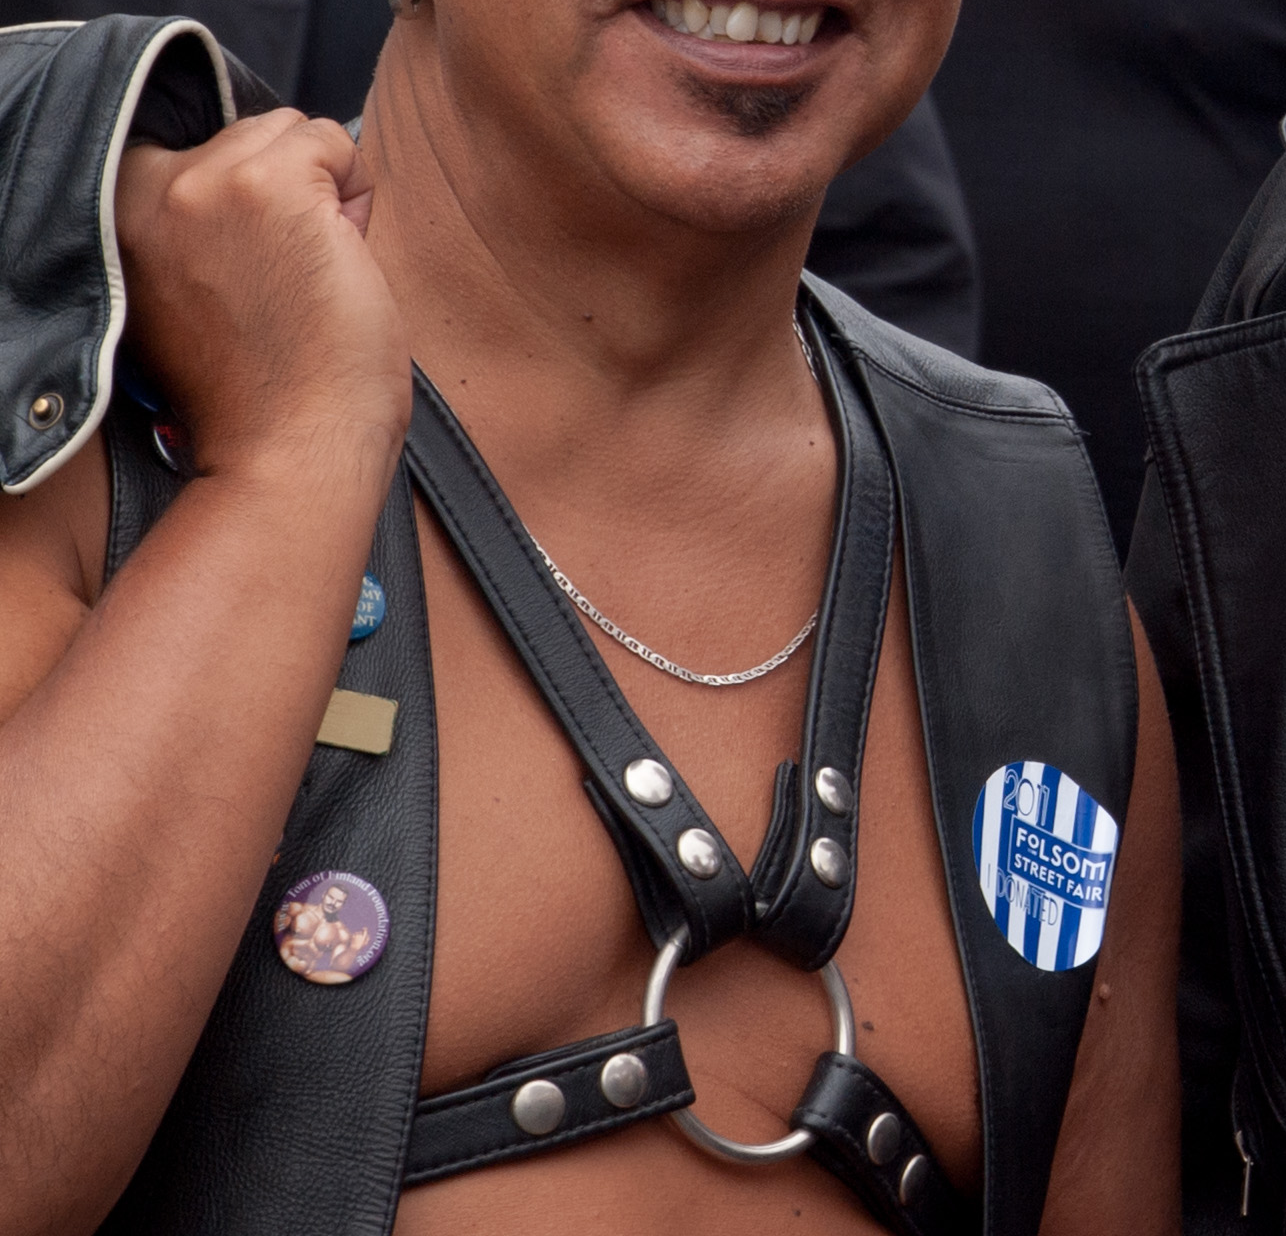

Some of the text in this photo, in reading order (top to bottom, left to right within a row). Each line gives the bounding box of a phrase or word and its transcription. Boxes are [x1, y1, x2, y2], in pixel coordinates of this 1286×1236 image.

[1003, 768, 1050, 827] 2011
[996, 866, 1058, 926] DONATED
[1014, 853, 1103, 903] STREET FAIR
[287, 879, 311, 898] Tom
[312, 871, 326, 883] of
[327, 870, 371, 892] Finland
[357, 889, 389, 967] Foundation.org
